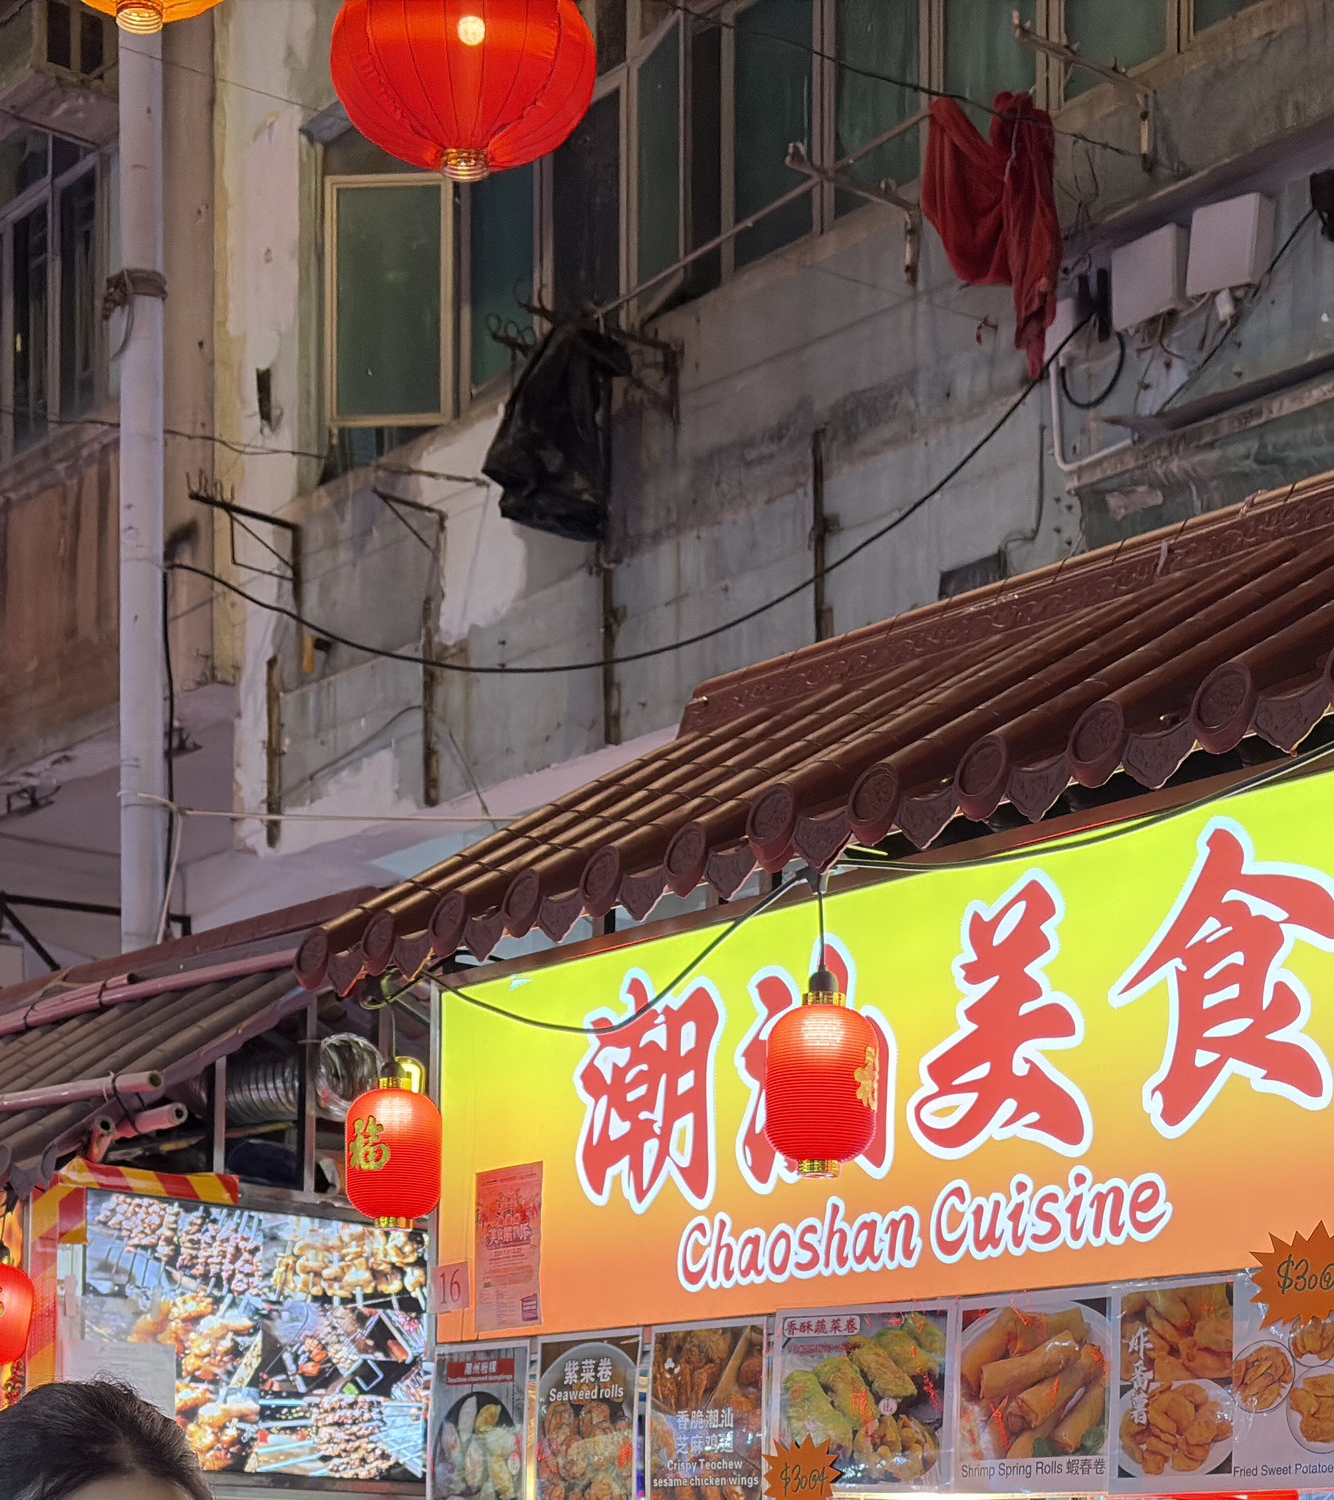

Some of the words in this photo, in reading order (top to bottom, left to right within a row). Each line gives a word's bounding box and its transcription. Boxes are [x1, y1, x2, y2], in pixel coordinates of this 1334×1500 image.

[679, 1196, 921, 1292] Chaoshan
[931, 1168, 1172, 1270] Cuisine
[439, 1269, 461, 1305] 16
[784, 1316, 858, 1335] 香酥蔬菜卷
[564, 1357, 612, 1385] 紫菜卷
[1127, 1327, 1155, 1426] 炸番薯
[549, 1386, 598, 1401] Seaweed
[600, 1384, 624, 1399] rolls
[676, 1407, 734, 1430] 香脆潮汕
[667, 1458, 698, 1474] Crispy
[699, 1457, 743, 1472] Teochew
[961, 1462, 995, 1482] Shrimp
[998, 1460, 1032, 1481] Spring
[1036, 1460, 1063, 1476] Rolls
[1232, 1465, 1259, 1479] Fried
[1261, 1463, 1292, 1478] Sweet
[653, 1476, 688, 1488] sesame
[690, 1474, 727, 1487] chicken
[729, 1473, 759, 1489] wings
